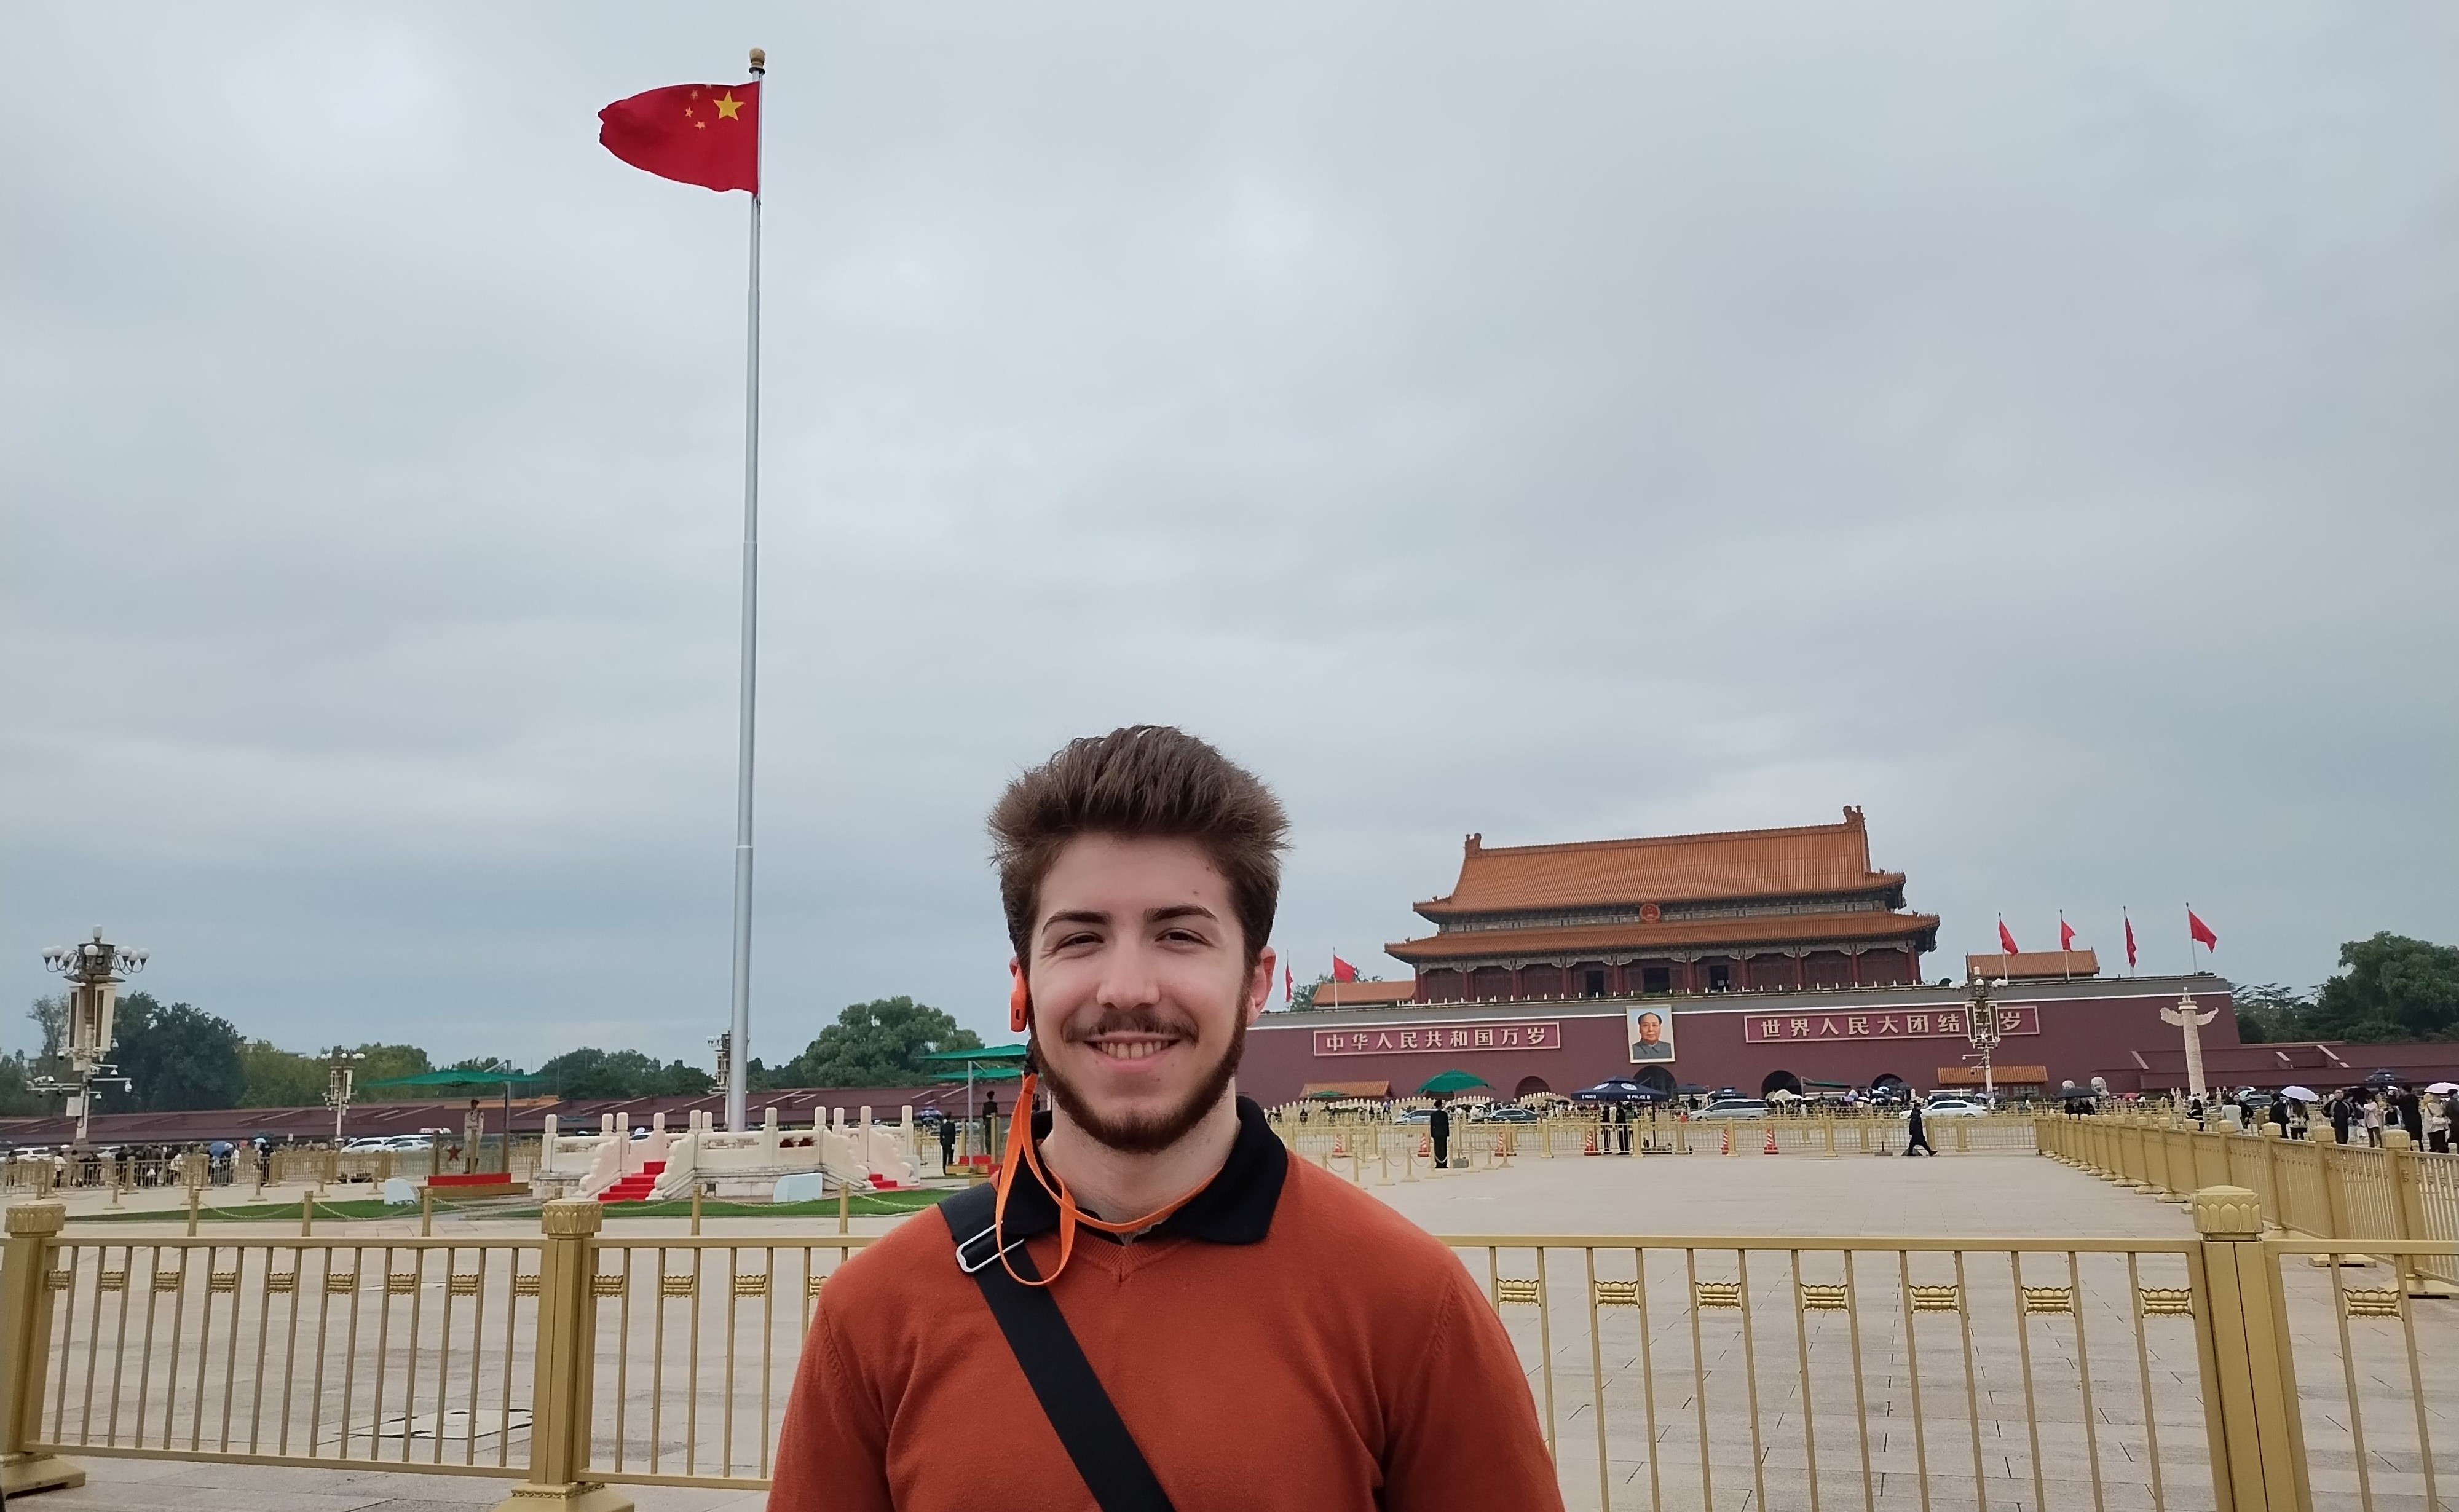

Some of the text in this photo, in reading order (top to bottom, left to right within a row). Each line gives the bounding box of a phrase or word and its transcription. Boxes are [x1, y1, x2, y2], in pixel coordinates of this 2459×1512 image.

[1761, 1011, 2021, 1038] 世界人民大团结岁
[1327, 1027, 1545, 1051] 中华人民共和国万岁
